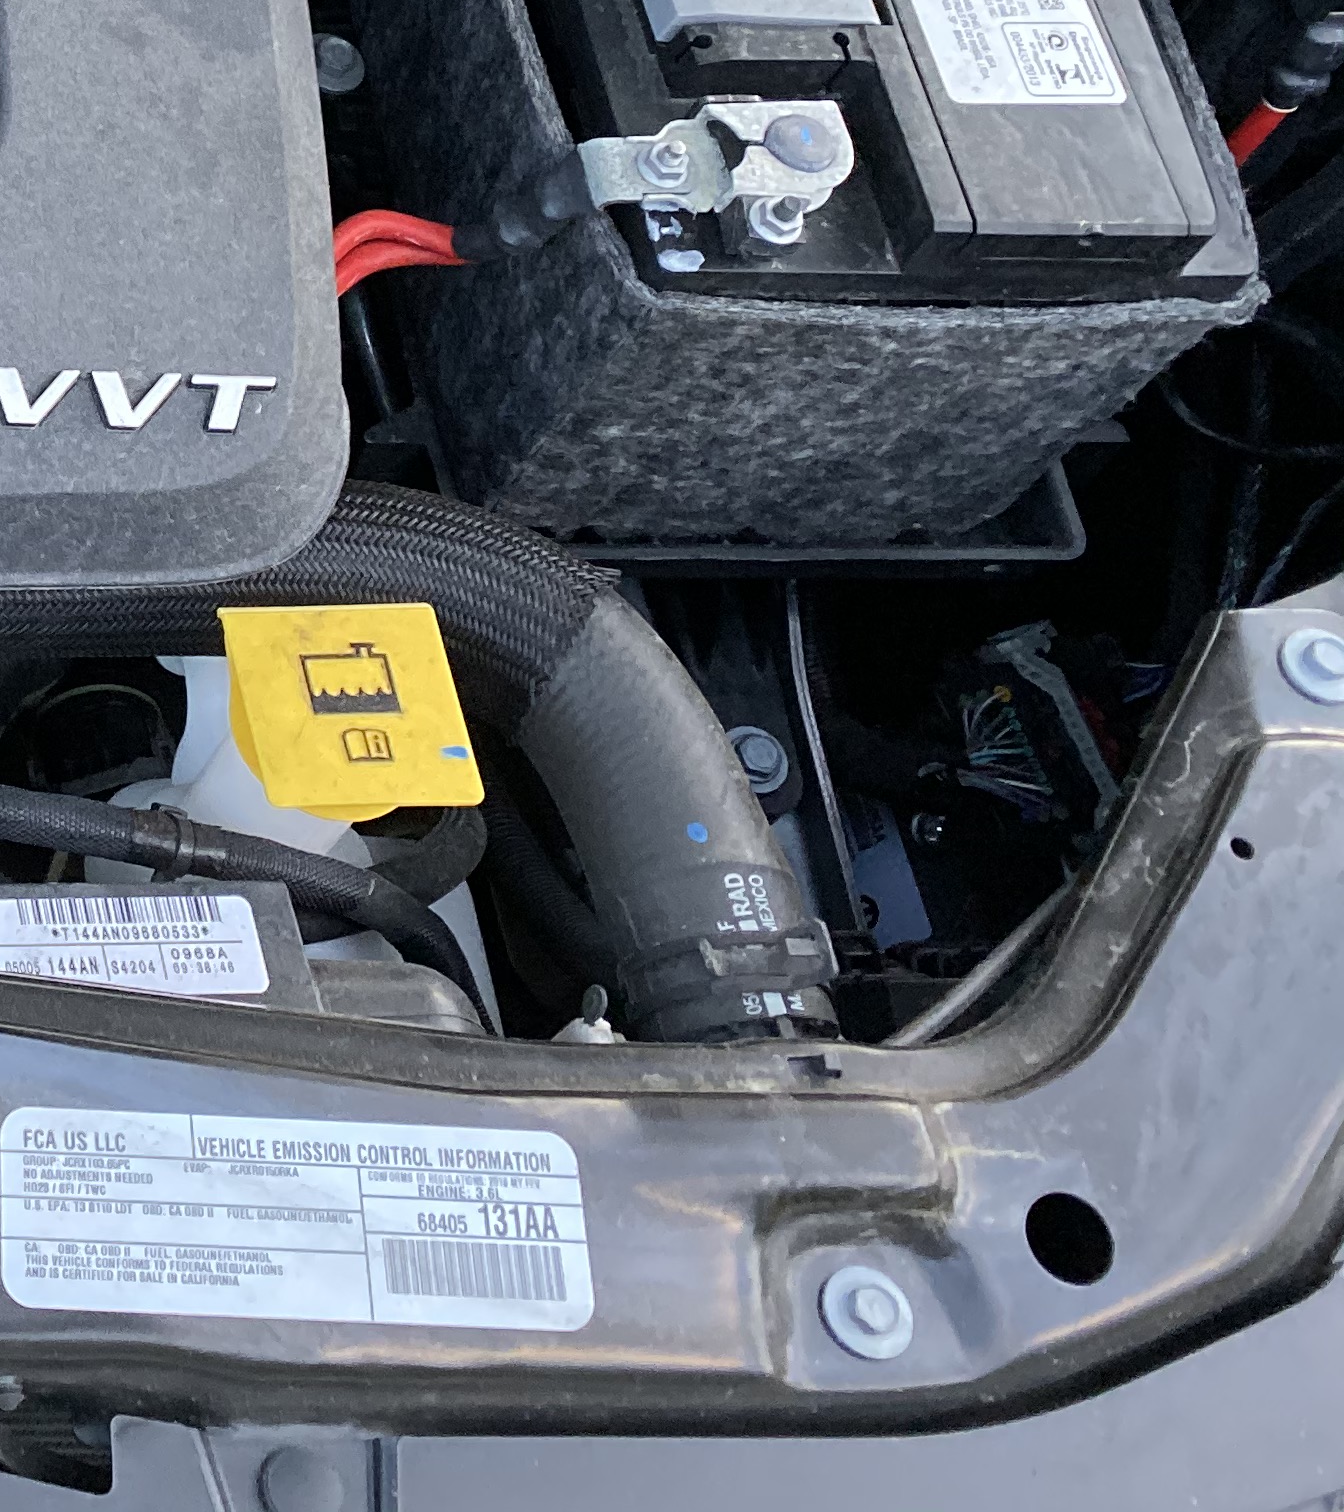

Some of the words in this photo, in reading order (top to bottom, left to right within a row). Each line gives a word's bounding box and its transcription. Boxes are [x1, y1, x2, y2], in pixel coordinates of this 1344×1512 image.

[724, 873, 753, 917] RAD
[49, 957, 99, 974] 144AN
[112, 961, 155, 974] S4204
[22, 1129, 56, 1149] FCA
[64, 1131, 90, 1151] US
[95, 1132, 126, 1152] LLC
[197, 1137, 265, 1158] VEHICLE
[272, 1139, 351, 1163] EMISSION
[357, 1144, 432, 1167] CONTROL
[438, 1148, 551, 1172] INFORMATION
[23, 1169, 38, 1179] NO
[40, 1170, 111, 1183] ADJUSTMENTS
[115, 1173, 153, 1184] NEEDED
[418, 1185, 471, 1199] ENGINE:
[476, 1187, 502, 1201] 3.6L
[417, 1212, 468, 1233] 68405
[478, 1203, 560, 1238] 131AA
[25, 1254, 49, 1266] THIS
[52, 1255, 93, 1268] VEHICLE
[96, 1257, 150, 1271] CONFORMS
[154, 1259, 166, 1271] TO
[170, 1260, 212, 1273] FEDERAL
[216, 1262, 283, 1276] REGULATIONS
[25, 1267, 46, 1279] AND
[49, 1267, 59, 1279] IS
[62, 1268, 113, 1281] CERTIFIED
[117, 1270, 137, 1282] FOR
[139, 1271, 163, 1283] SALE
[167, 1273, 178, 1283] IN
[180, 1273, 239, 1286] CALIFORNIA
